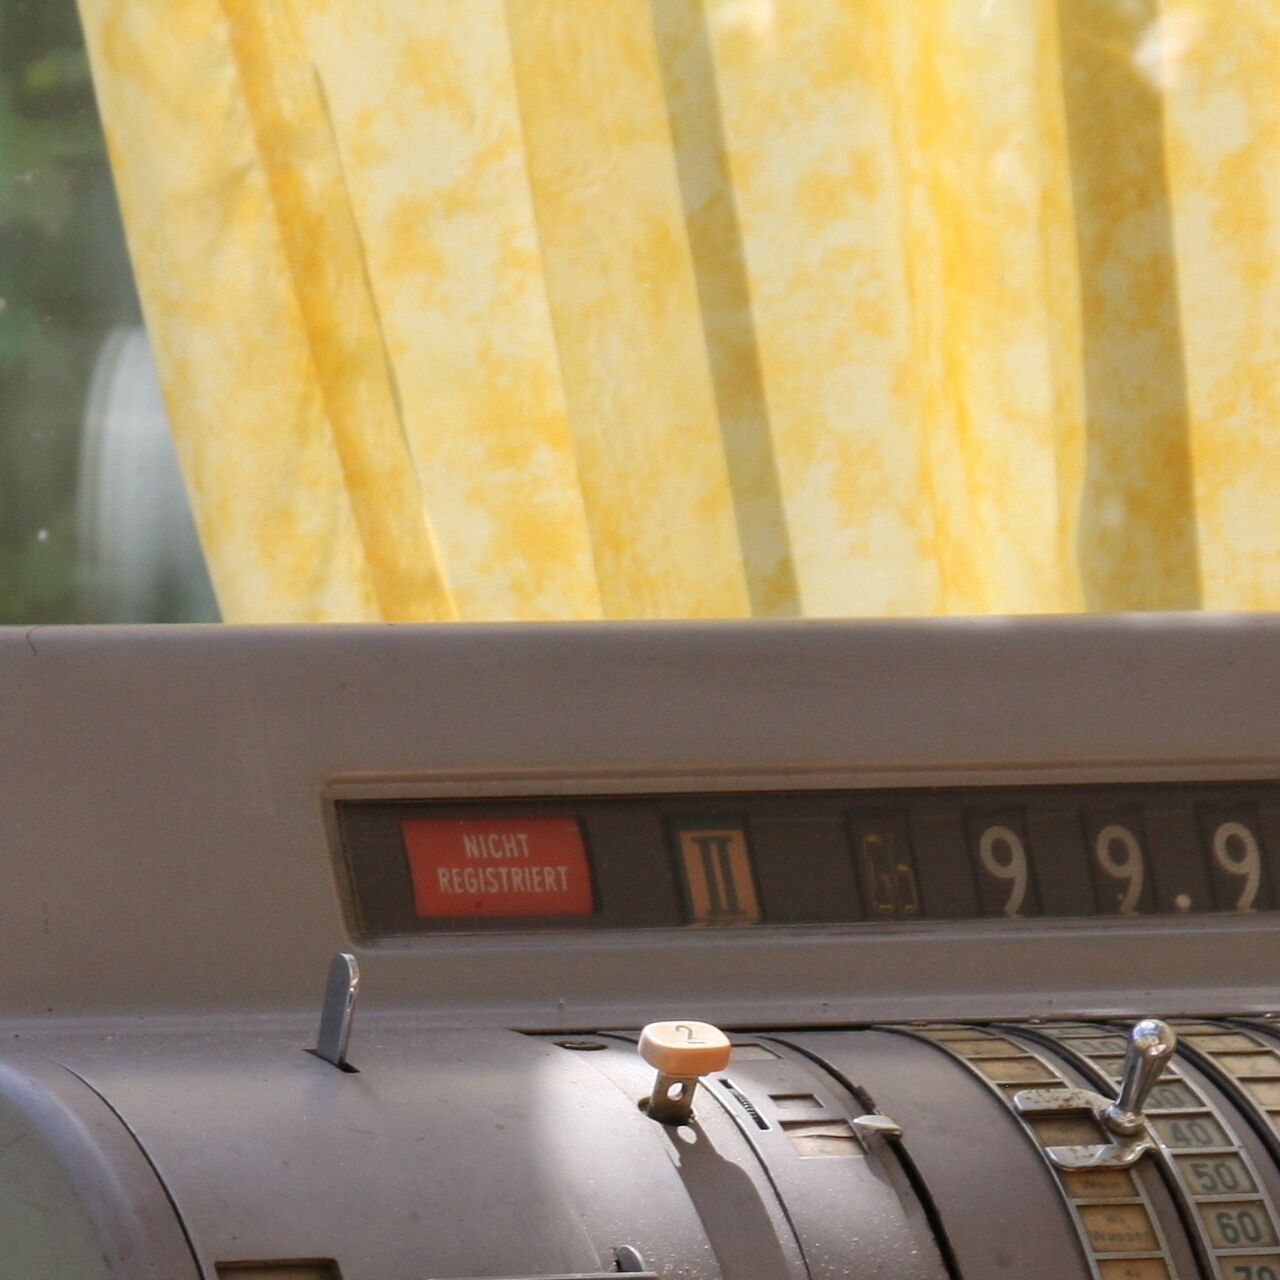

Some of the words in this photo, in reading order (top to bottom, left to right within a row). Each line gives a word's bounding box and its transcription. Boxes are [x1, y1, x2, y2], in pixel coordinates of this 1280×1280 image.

[462, 833, 530, 858] NICHT
[436, 866, 569, 893] REGISTRIERT
[674, 1024, 707, 1045] 2
[1171, 1121, 1213, 1146] 40
[1190, 1161, 1239, 1192] 50
[1215, 1211, 1262, 1244] 60
